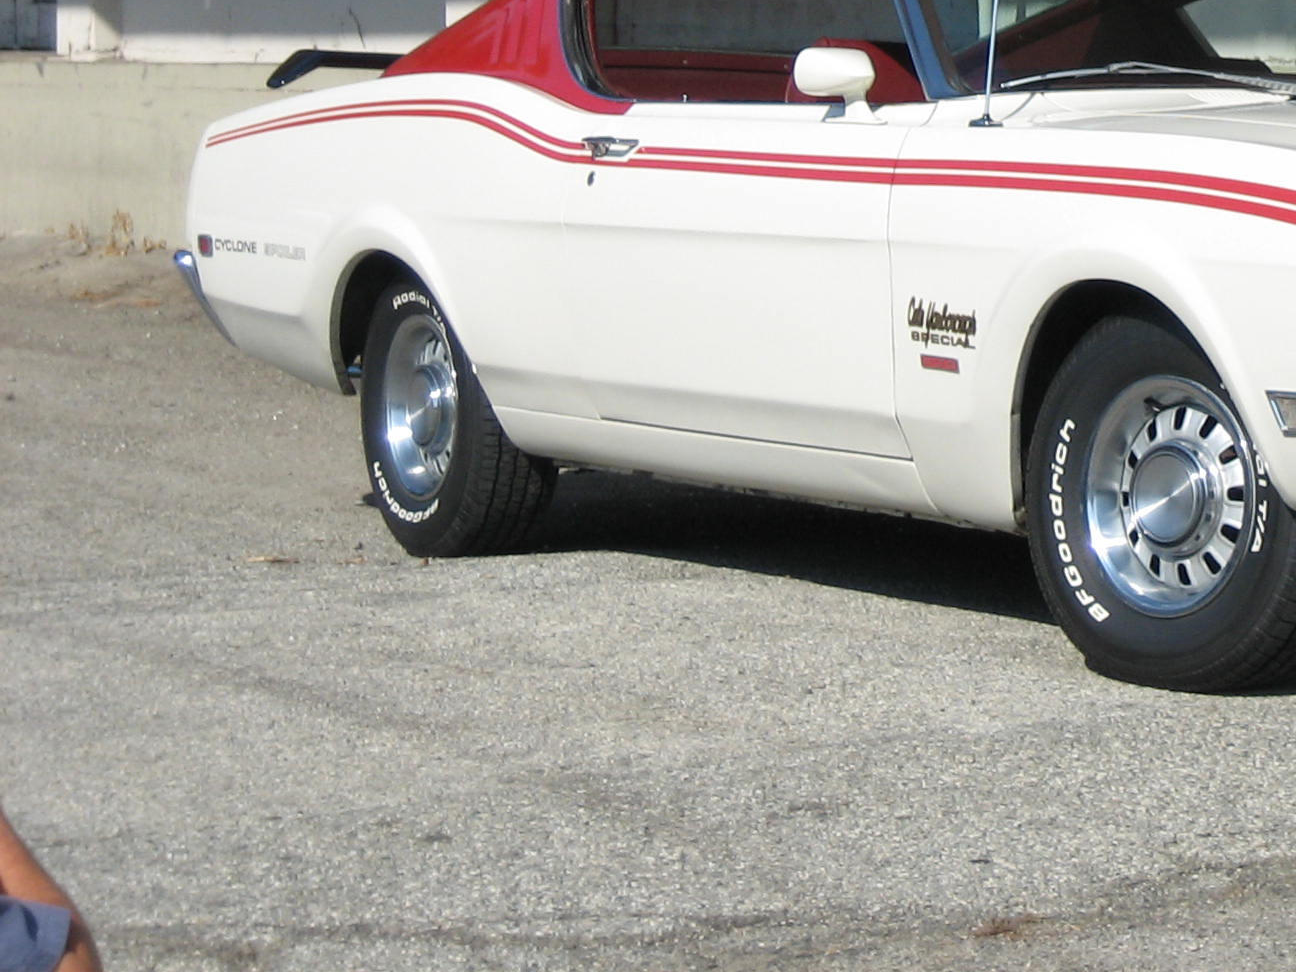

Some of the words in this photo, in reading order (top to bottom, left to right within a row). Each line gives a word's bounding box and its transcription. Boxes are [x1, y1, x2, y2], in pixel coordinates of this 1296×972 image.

[215, 238, 257, 254] CYCLONE
[911, 331, 976, 349] SPECIAL
[1049, 417, 1110, 623] BFGoodrich
